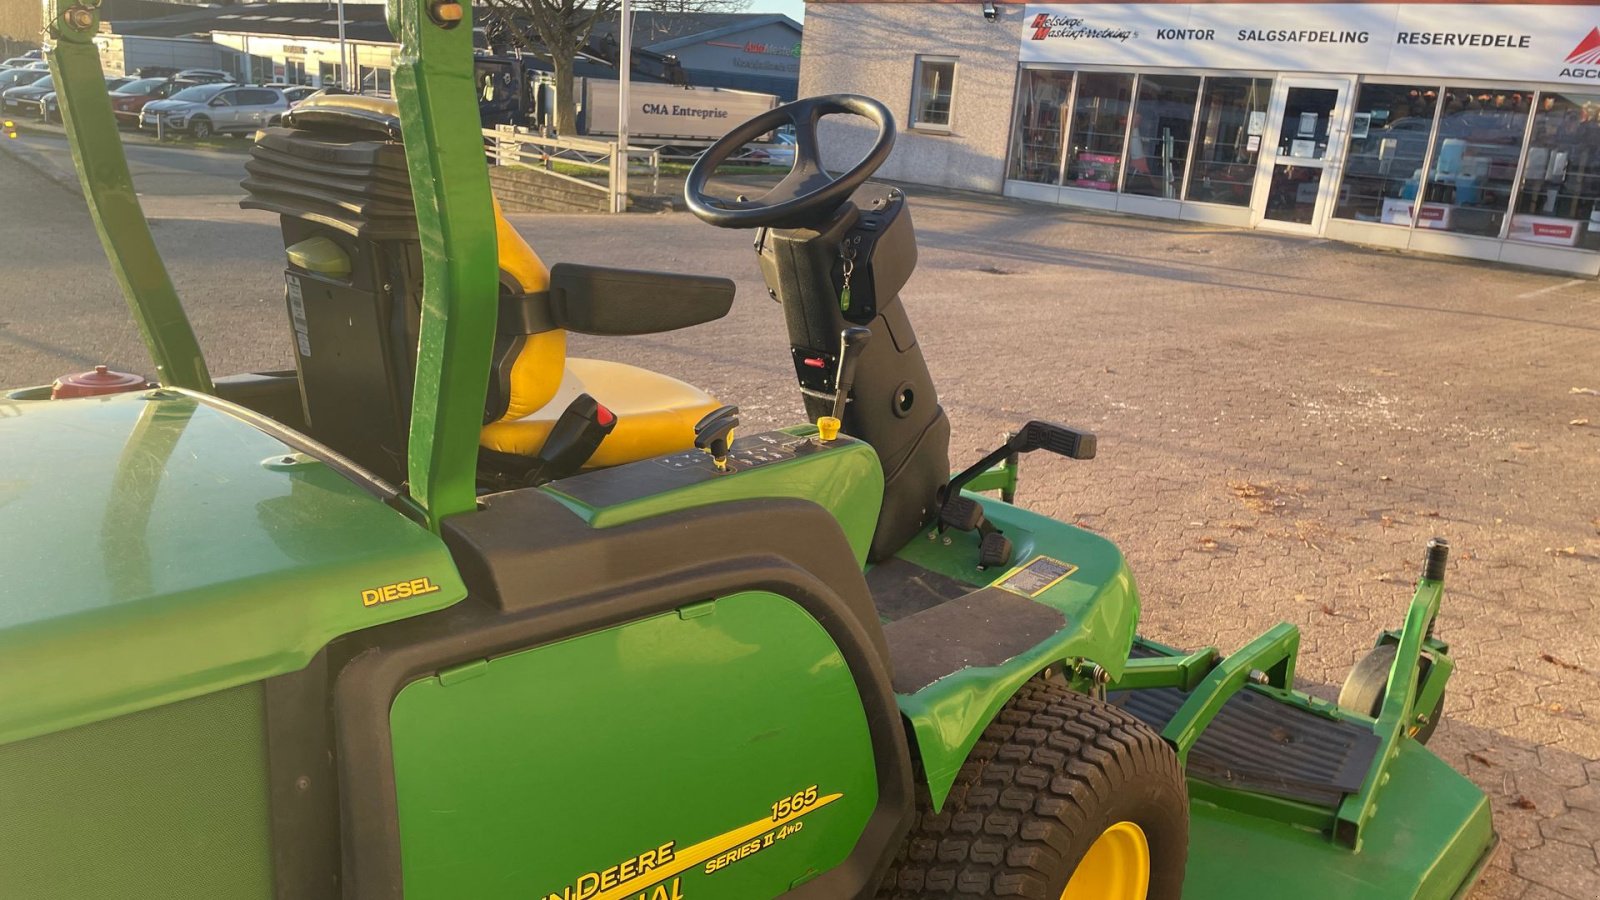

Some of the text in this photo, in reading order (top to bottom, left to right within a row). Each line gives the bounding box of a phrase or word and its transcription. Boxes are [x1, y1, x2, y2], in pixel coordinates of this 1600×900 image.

[1031, 13, 1084, 28] Helsinge
[1156, 29, 1215, 40] KONTOR
[1237, 30, 1369, 43] SALGSAFDELING
[1396, 32, 1531, 48] RESERVEDELE
[1559, 68, 1600, 79] AGC
[642, 103, 728, 119] CMA Entreprise
[361, 577, 439, 606] DIESEL
[771, 784, 818, 821] 1565
[704, 821, 803, 874] SERIES II 4WD
[576, 840, 676, 900] DEERE
